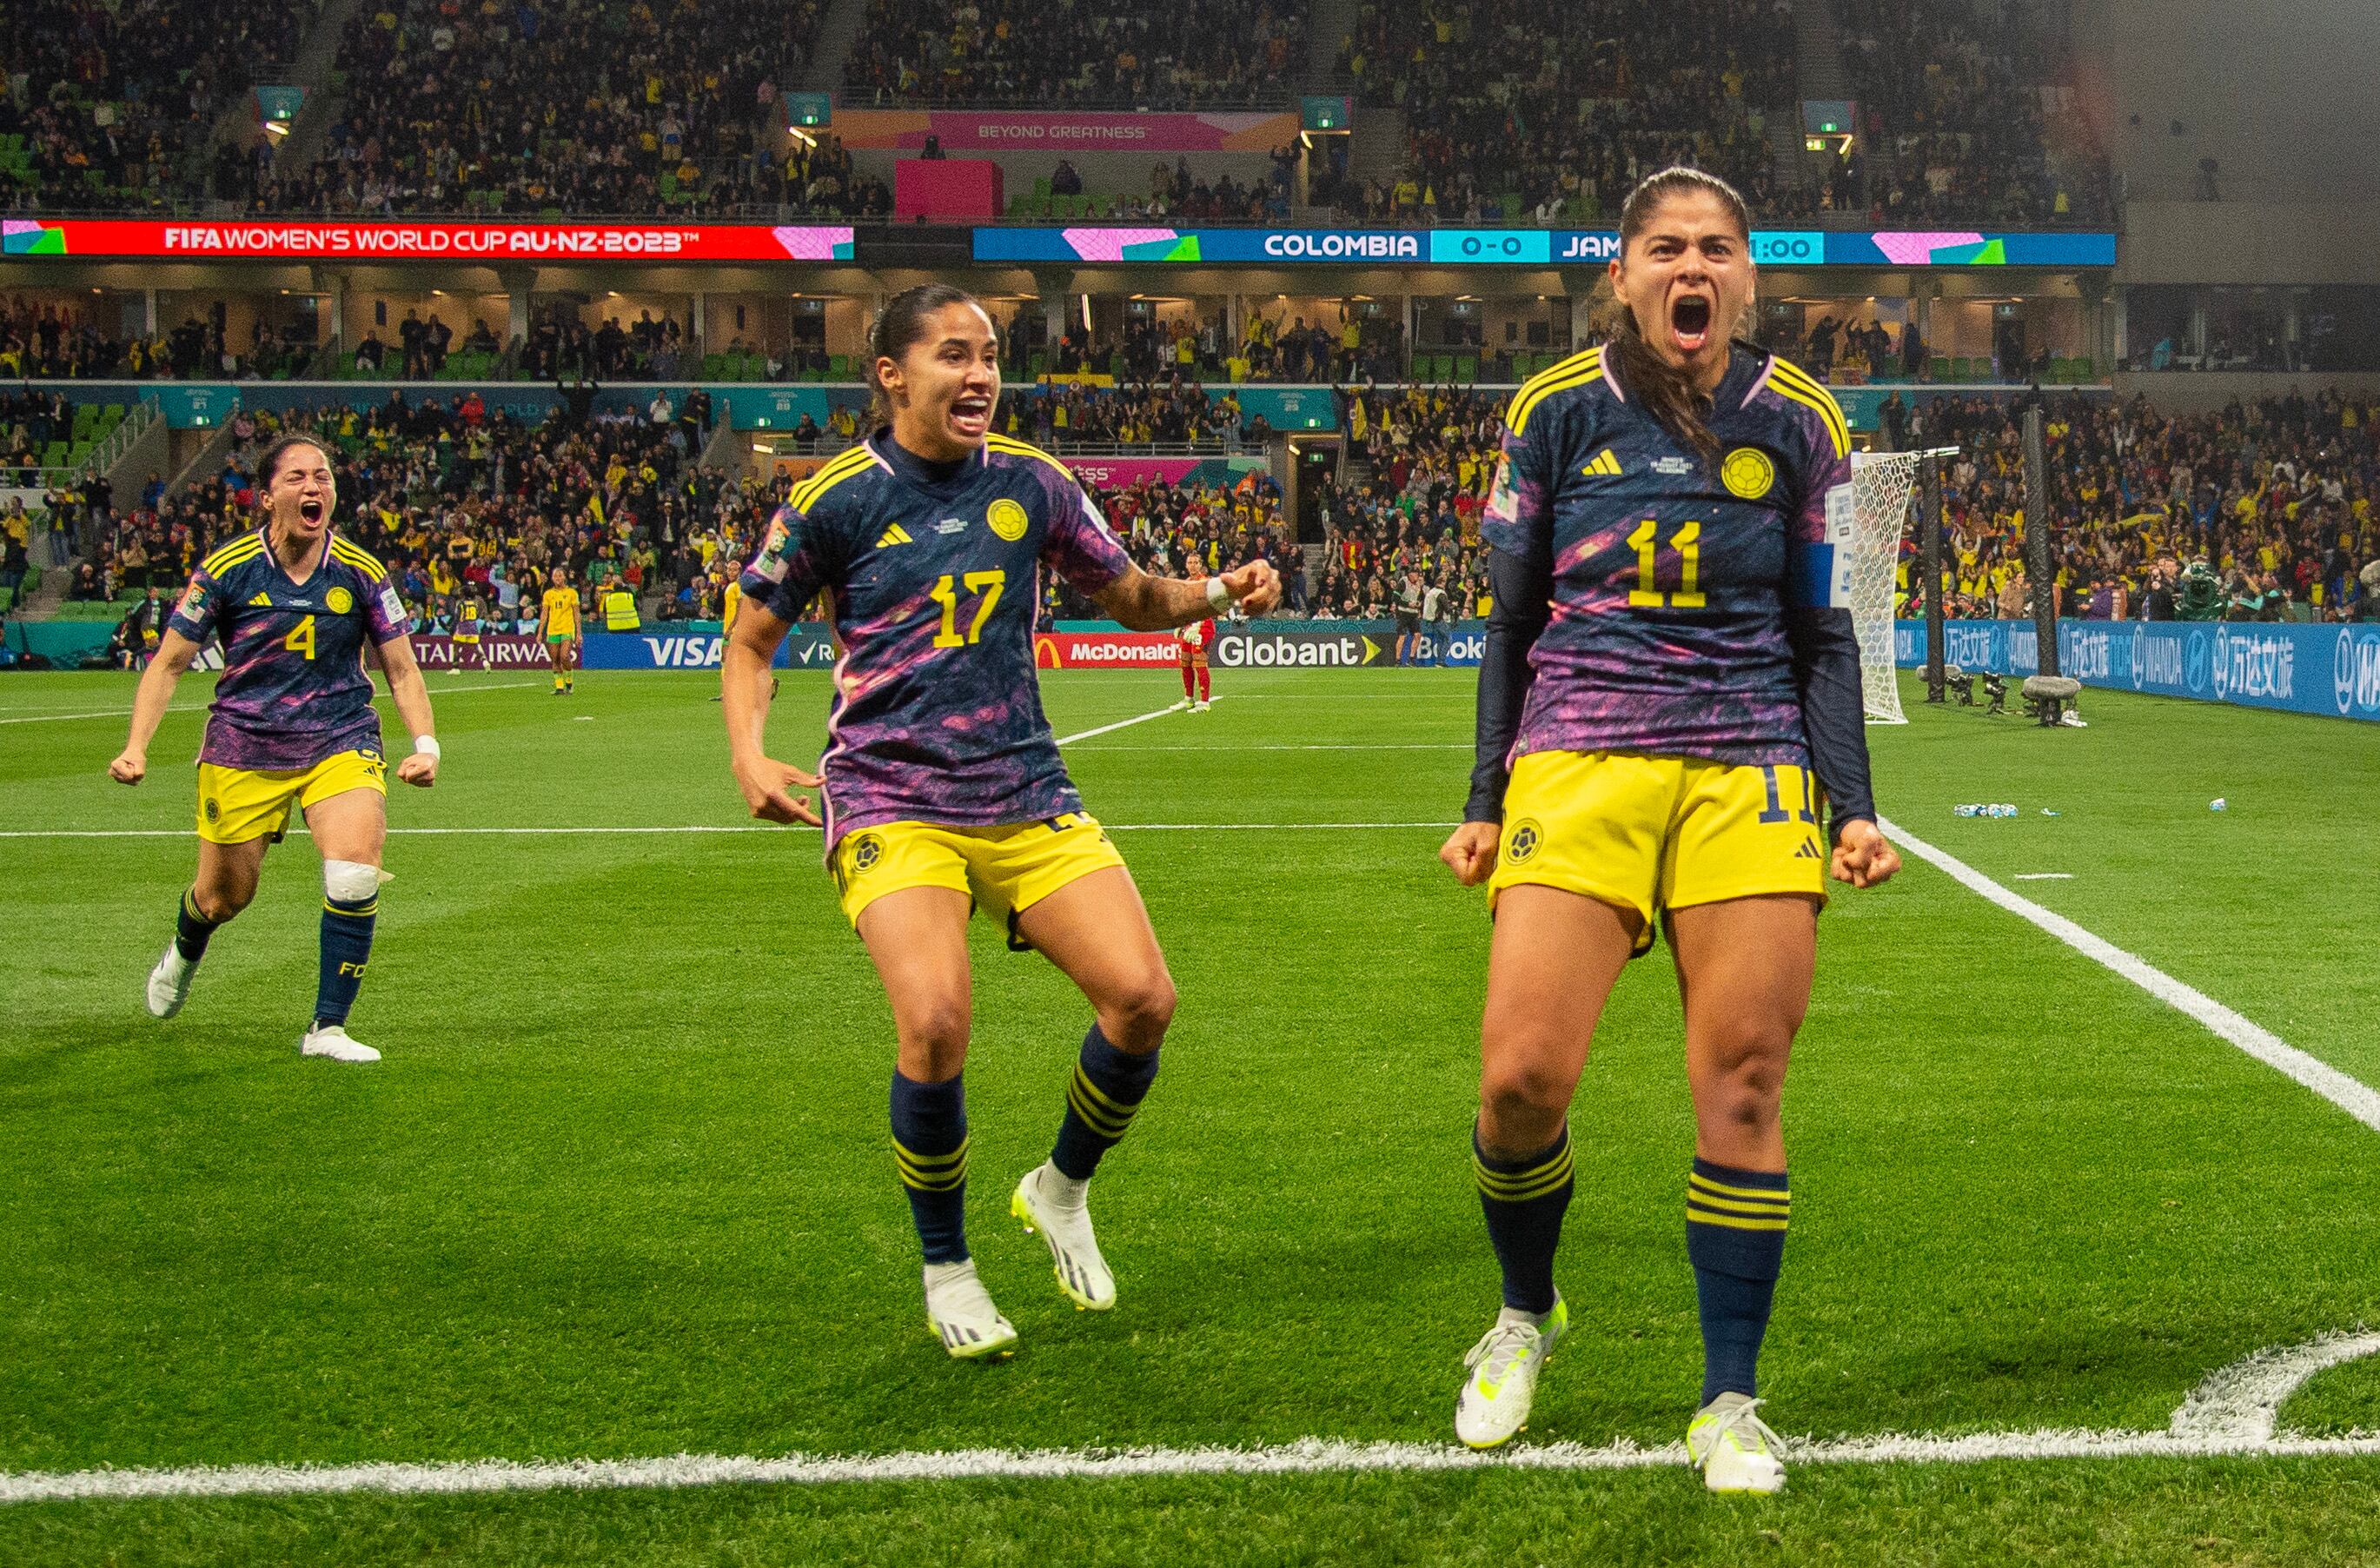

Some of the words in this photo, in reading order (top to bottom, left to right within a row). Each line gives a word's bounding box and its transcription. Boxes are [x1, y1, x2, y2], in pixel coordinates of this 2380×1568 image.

[978, 125, 1044, 138] BEYOND
[1049, 126, 1146, 139] GREATNESS
[165, 228, 222, 249] FIFA
[223, 229, 351, 251] WOMEN'S
[355, 229, 450, 251] WORLD
[453, 230, 507, 252] CUP
[1264, 235, 1418, 256] COLOMBIA
[1562, 236, 1621, 258] JAM
[1626, 519, 1706, 608] 11
[930, 569, 1006, 648] 17
[285, 614, 315, 661] 4
[1217, 636, 1359, 666] Globant
[471, 643, 578, 663] AIRWAS
[642, 638, 723, 666] VISA
[2145, 636, 2182, 685] WANDA
